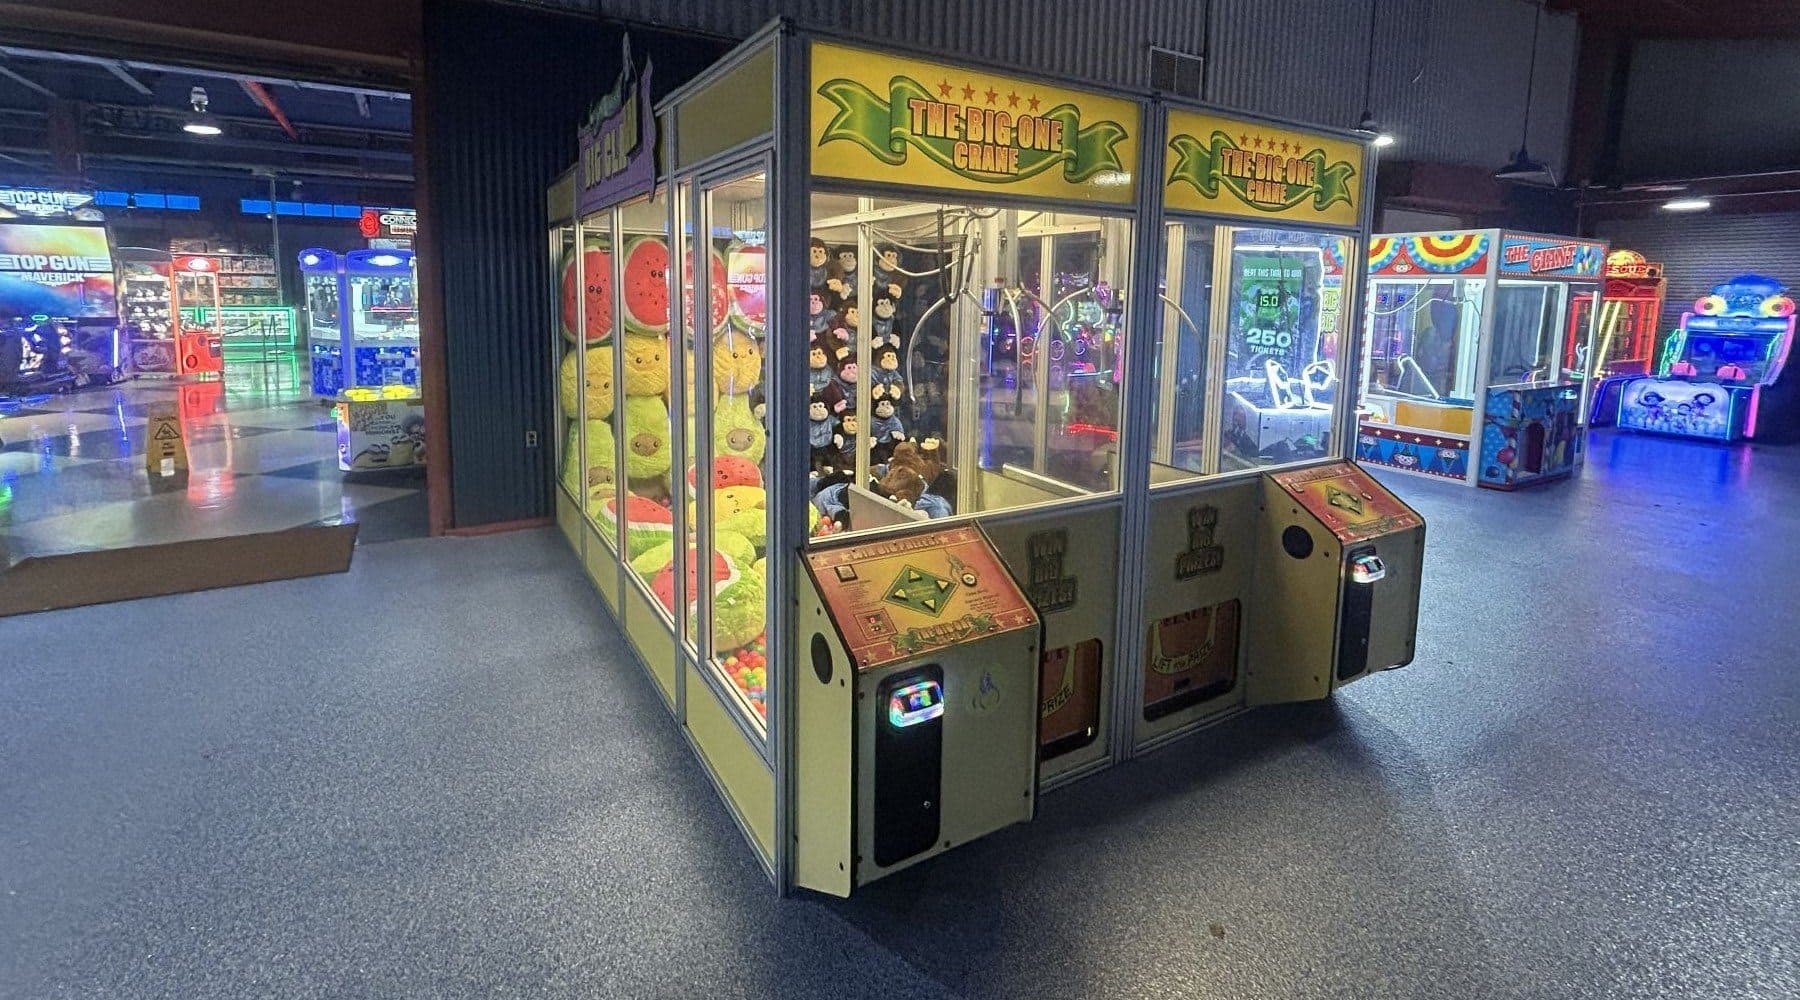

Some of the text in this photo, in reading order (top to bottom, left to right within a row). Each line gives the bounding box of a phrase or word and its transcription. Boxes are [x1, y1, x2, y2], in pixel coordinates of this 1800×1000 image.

[908, 98, 1064, 153] THE BIG ONE
[953, 141, 1019, 175] CRANE
[1221, 147, 1316, 189] THE BIG ONE
[9, 190, 67, 206] TOP GUN
[1246, 180, 1287, 205] CRANE
[10, 254, 90, 272] TOP GUN
[1505, 245, 1576, 272] THE GIANT
[21, 272, 84, 282] MAVERICK
[1246, 328, 1292, 348] 250
[1250, 345, 1285, 355] TICKETS
